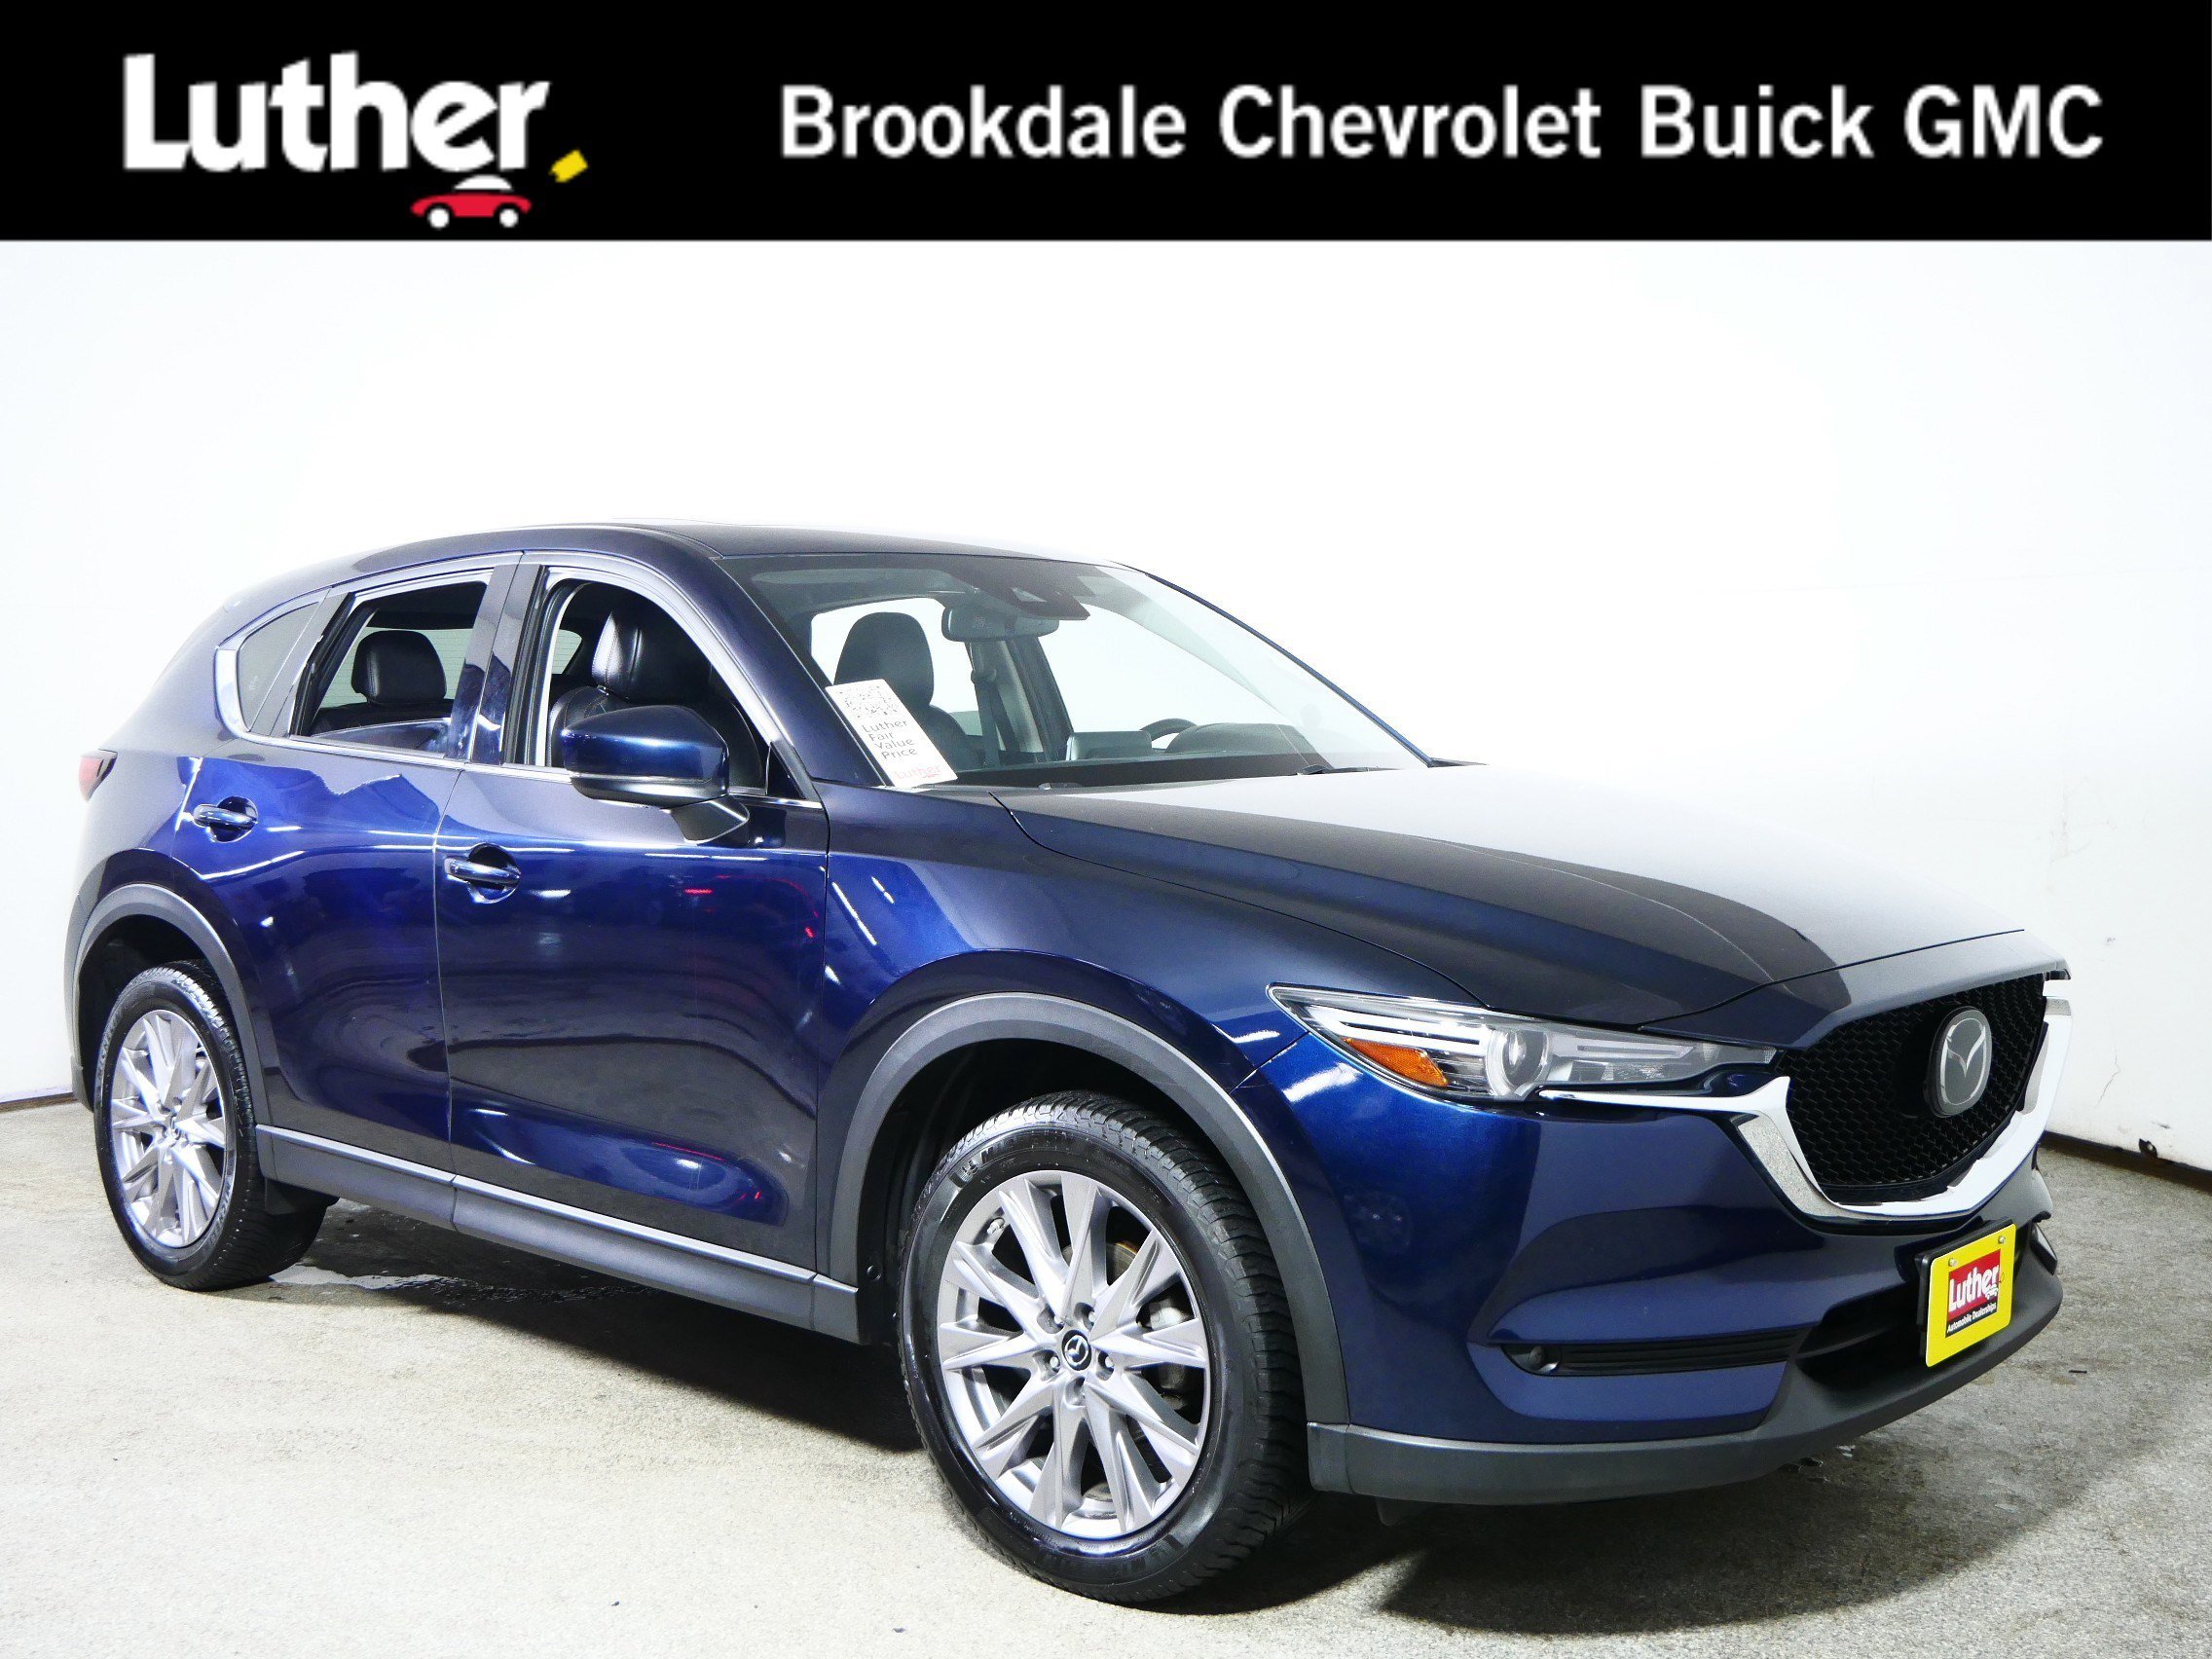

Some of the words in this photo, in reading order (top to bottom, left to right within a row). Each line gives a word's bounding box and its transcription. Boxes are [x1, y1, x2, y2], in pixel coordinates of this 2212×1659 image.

[862, 720, 907, 732] Luther
[868, 732, 894, 741] Fair
[874, 738, 914, 749] Value
[881, 748, 917, 759] Price
[894, 765, 940, 779] Luther
[1948, 1265, 2000, 1311] Luther
[1947, 1312, 1972, 1332] Automobile
[1972, 1302, 1997, 1319] Dealerships
